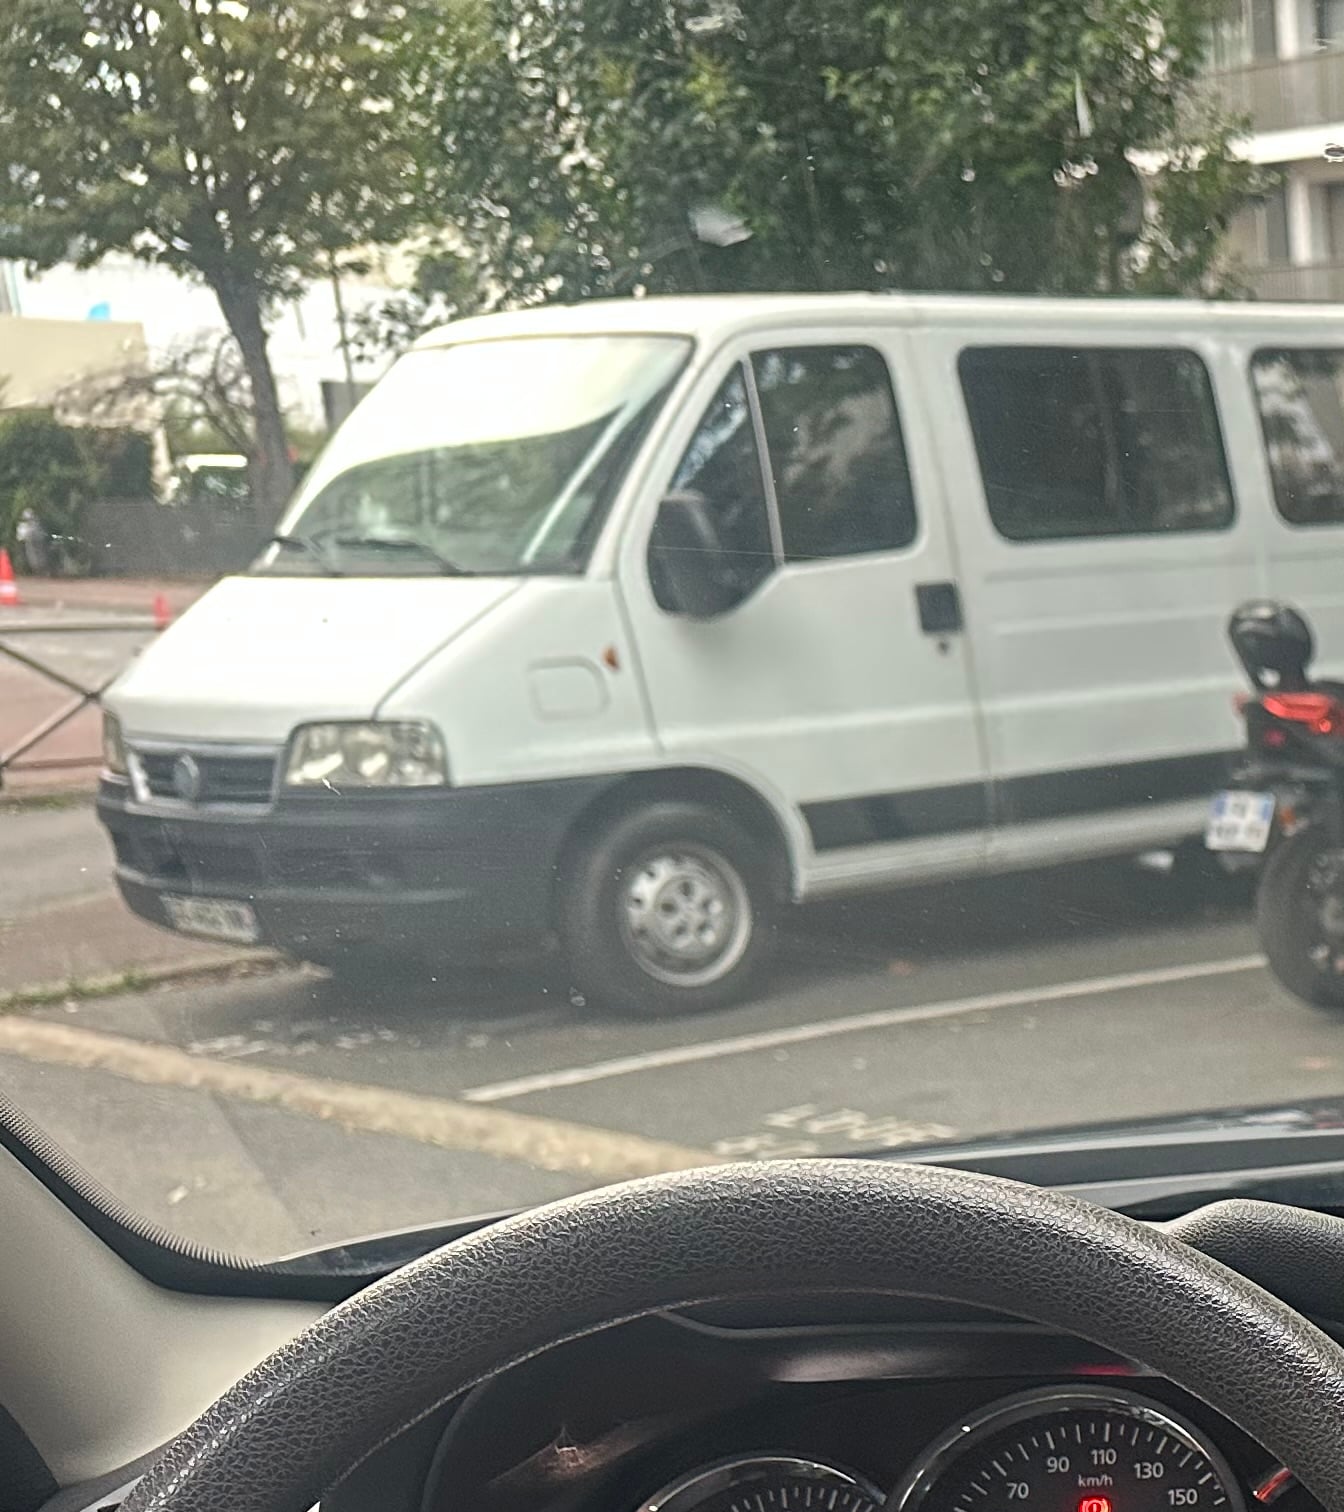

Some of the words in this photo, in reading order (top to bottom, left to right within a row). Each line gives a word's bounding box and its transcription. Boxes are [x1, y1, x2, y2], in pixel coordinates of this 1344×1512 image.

[1047, 1457, 1070, 1473] 90
[1091, 1449, 1117, 1465] 110
[1134, 1462, 1164, 1479] 130
[1077, 1474, 1113, 1487] km/h
[1006, 1483, 1029, 1499] 70
[1168, 1489, 1198, 1506] 150
